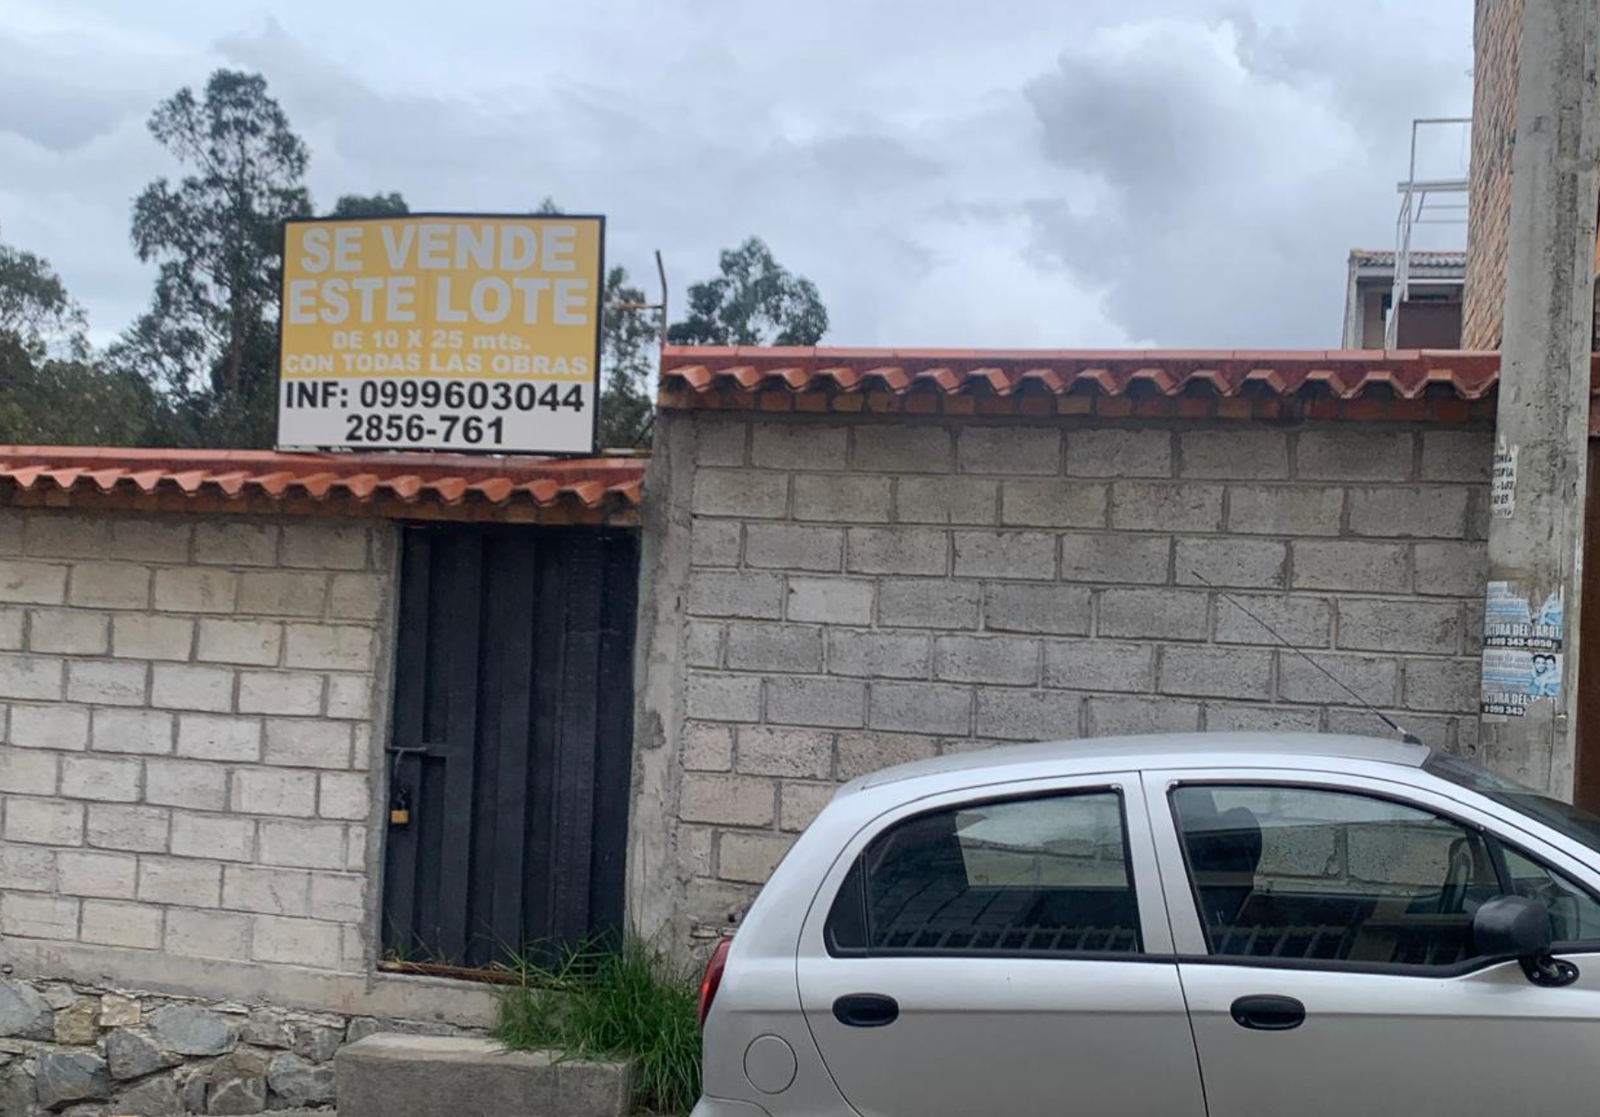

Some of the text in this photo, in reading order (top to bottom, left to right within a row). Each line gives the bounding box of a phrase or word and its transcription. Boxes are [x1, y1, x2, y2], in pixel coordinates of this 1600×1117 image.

[301, 224, 576, 273] SE VENDE
[288, 276, 588, 326] ESTE LOTE
[332, 329, 532, 351] DE 10 X 25 mts.
[285, 352, 588, 375] CON TODAS LAS OBRAS
[286, 380, 584, 412] INF: 0999603044
[346, 414, 503, 445] 2856-761
[1513, 623, 1528, 636] DEL
[1511, 693, 1528, 705] DEL
